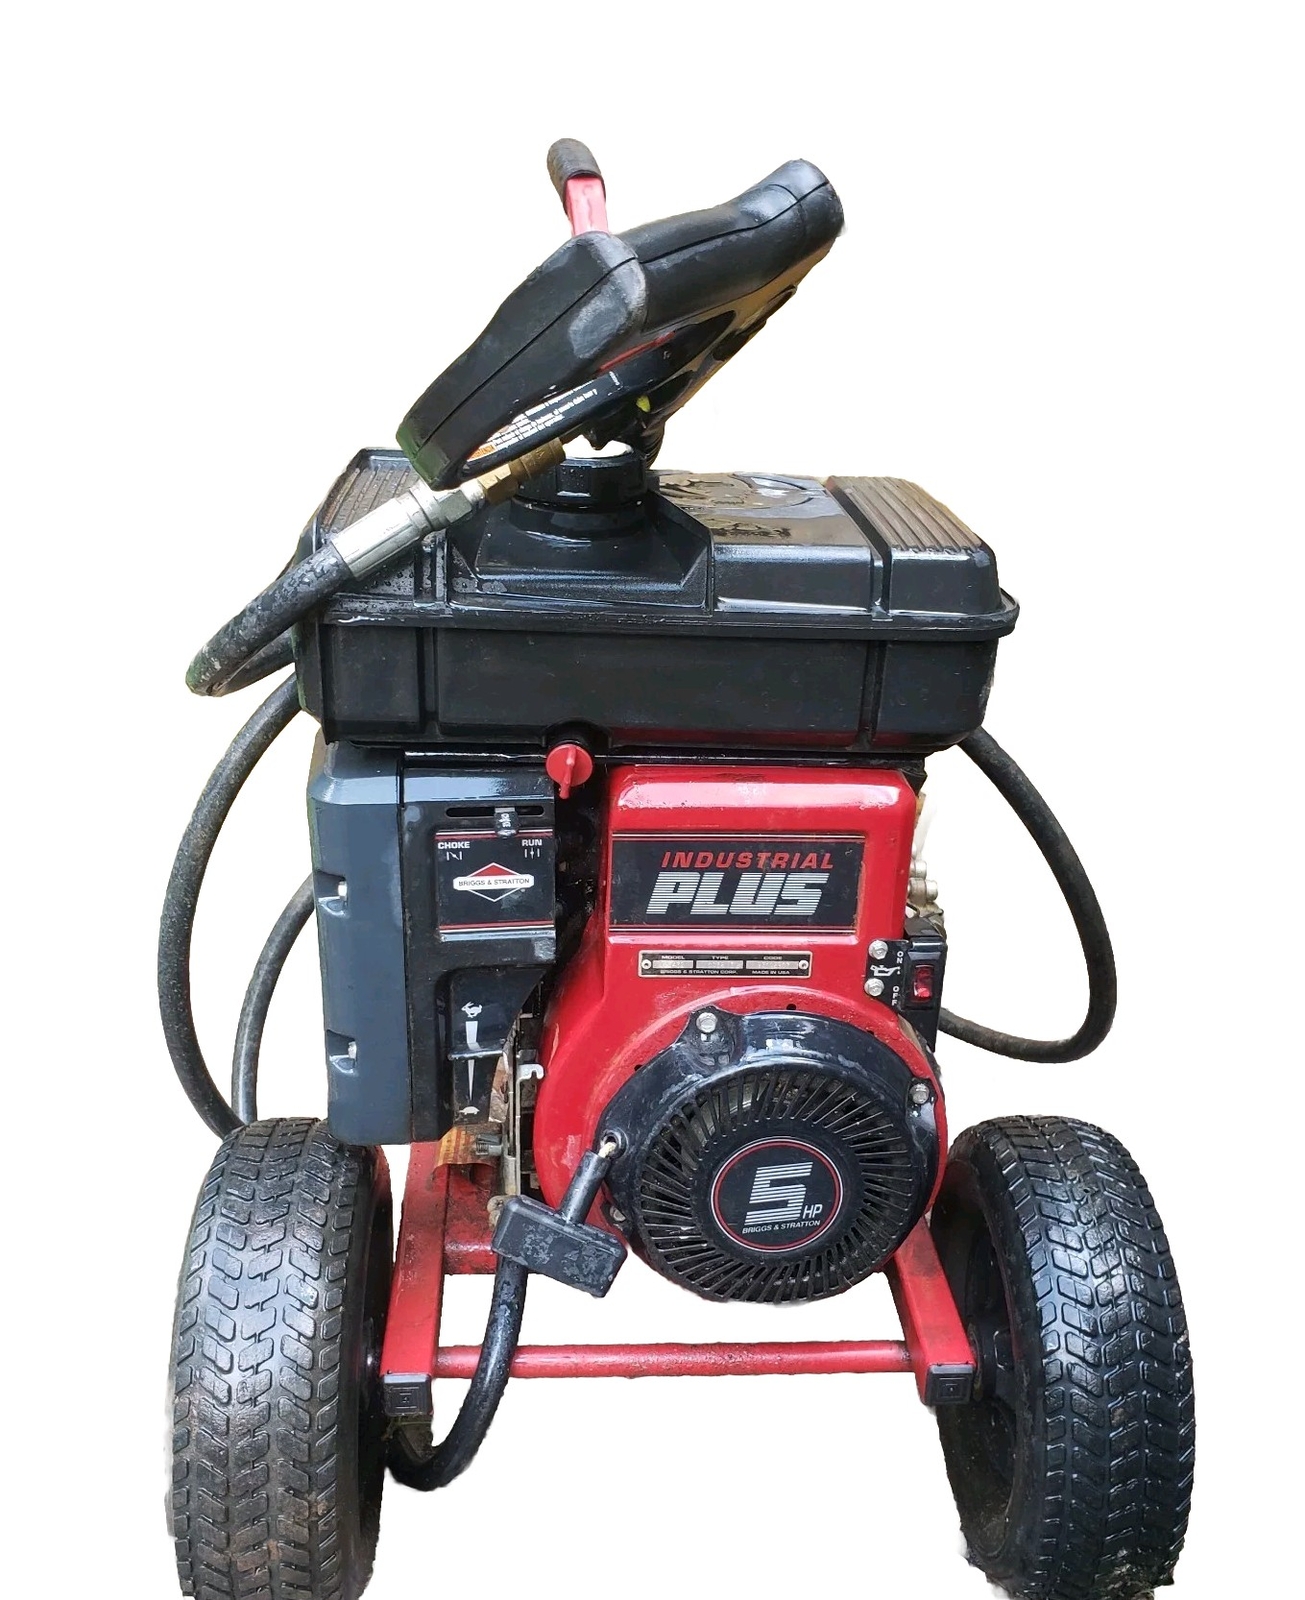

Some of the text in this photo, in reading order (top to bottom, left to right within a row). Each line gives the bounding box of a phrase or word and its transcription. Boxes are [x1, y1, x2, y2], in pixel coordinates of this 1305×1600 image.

[438, 841, 470, 849] CHOKE
[661, 852, 833, 869] INDUSTRIAL
[646, 872, 829, 915] PLUS
[896, 951, 904, 963] ON
[892, 986, 900, 1006] OFF
[744, 1162, 813, 1225] 5
[803, 1204, 823, 1219] HP
[742, 1224, 772, 1234] BRIGGS
[781, 1220, 820, 1229] STRATTON
